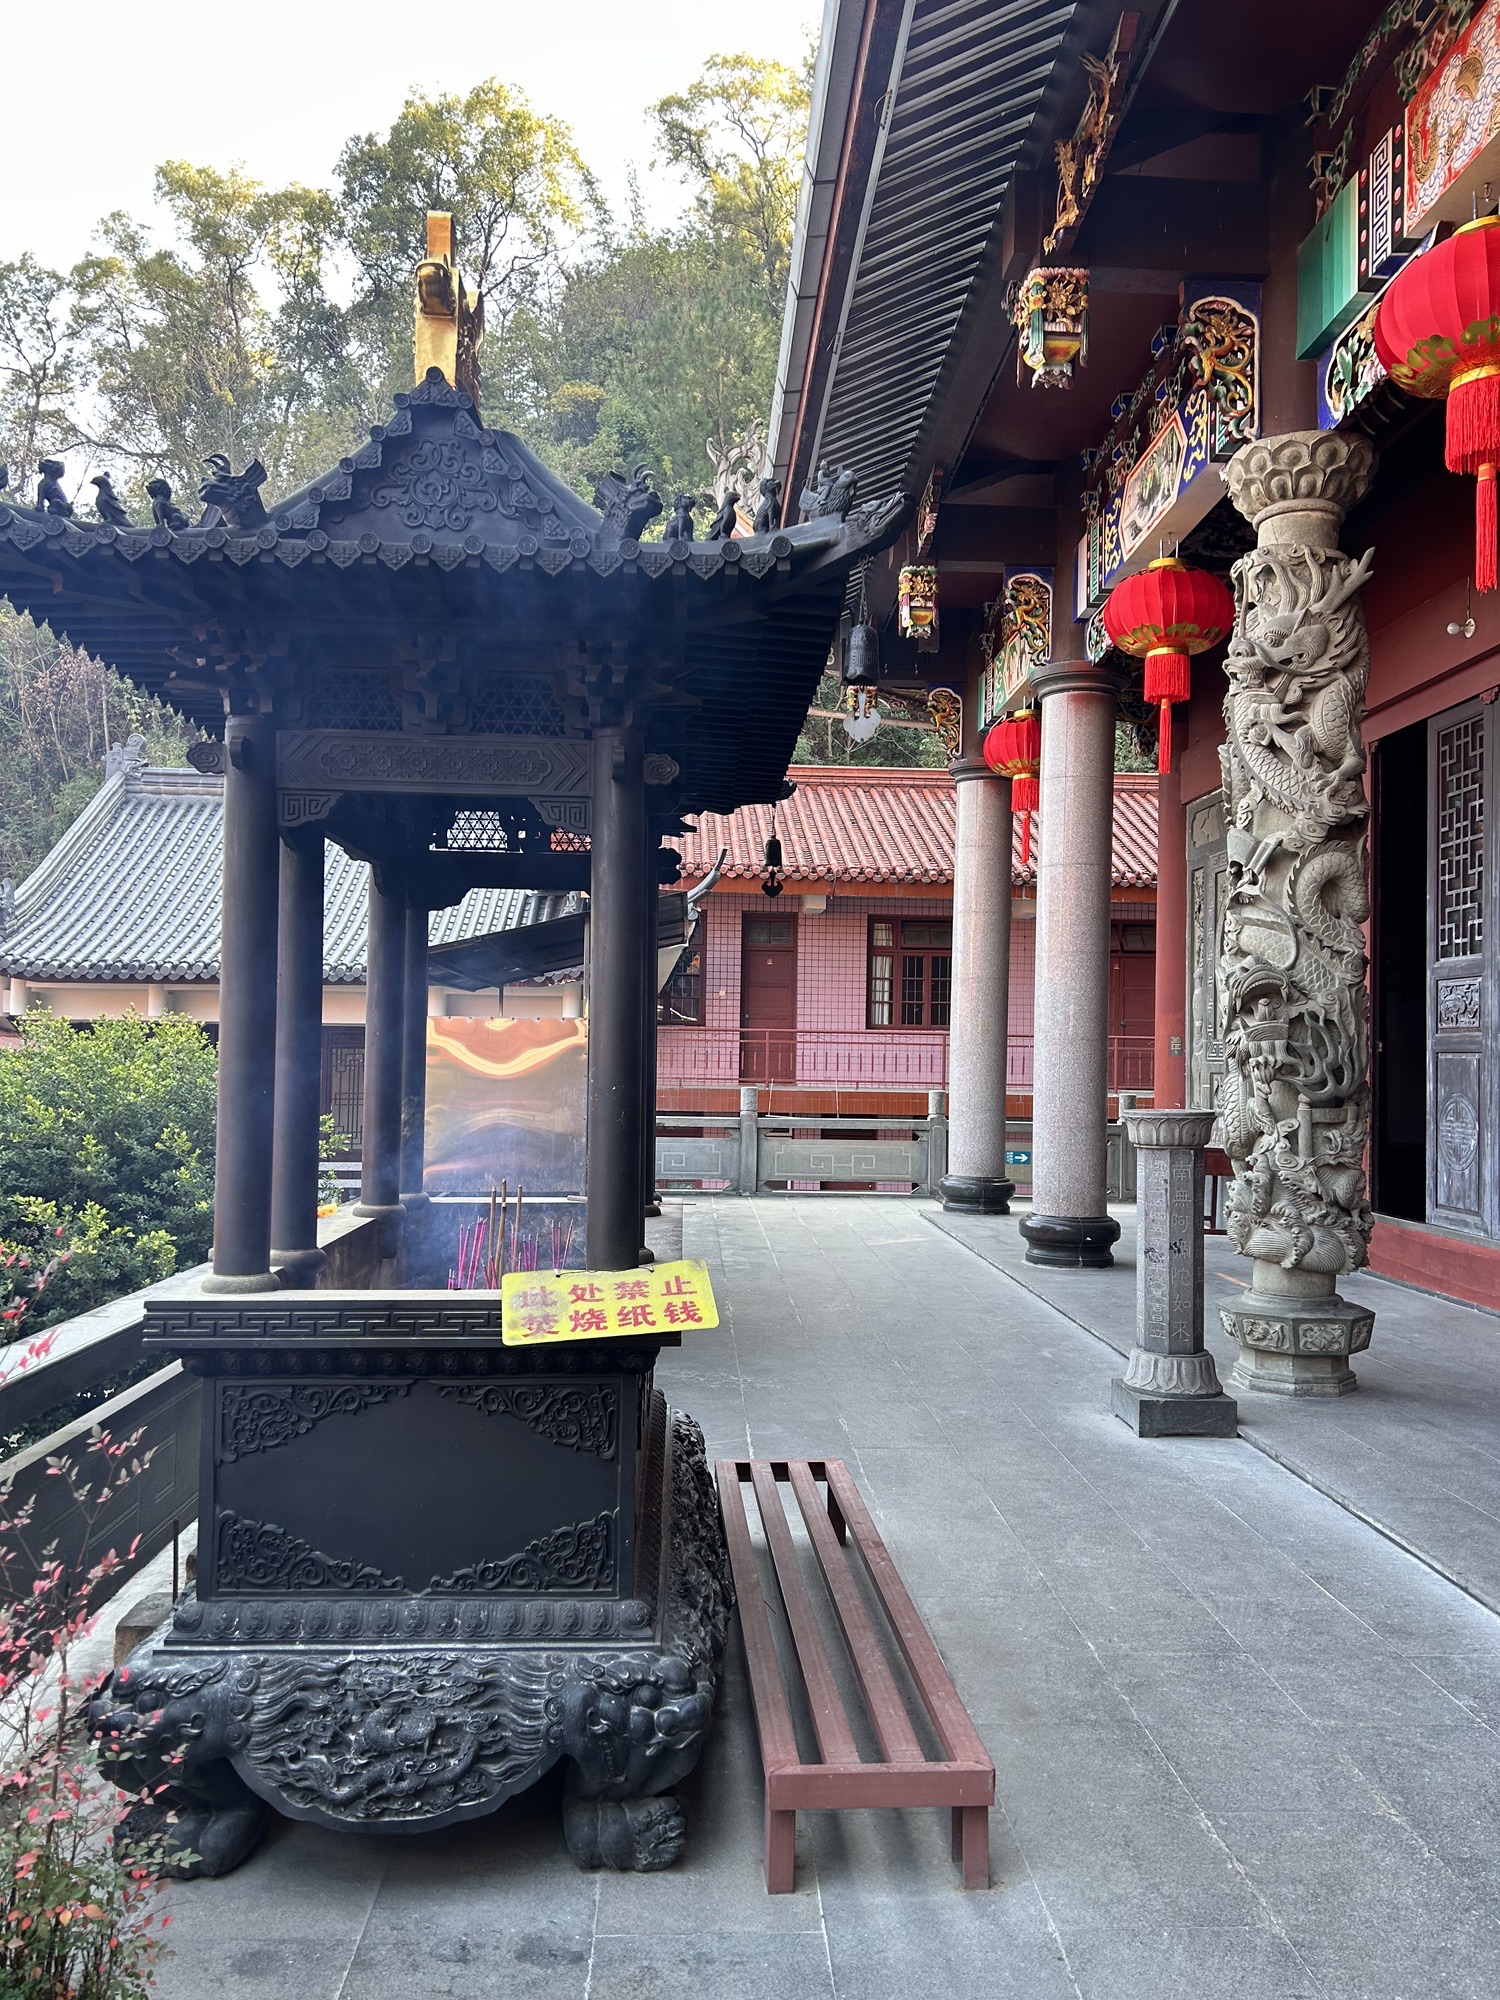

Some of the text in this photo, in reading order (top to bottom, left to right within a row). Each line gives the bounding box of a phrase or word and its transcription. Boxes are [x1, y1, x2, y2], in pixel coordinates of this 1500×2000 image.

[1171, 1161, 1193, 1339] 南無阿彌陀如來
[521, 1275, 698, 1308] 此处禁止
[522, 1301, 703, 1338] 焚烧纸钱
